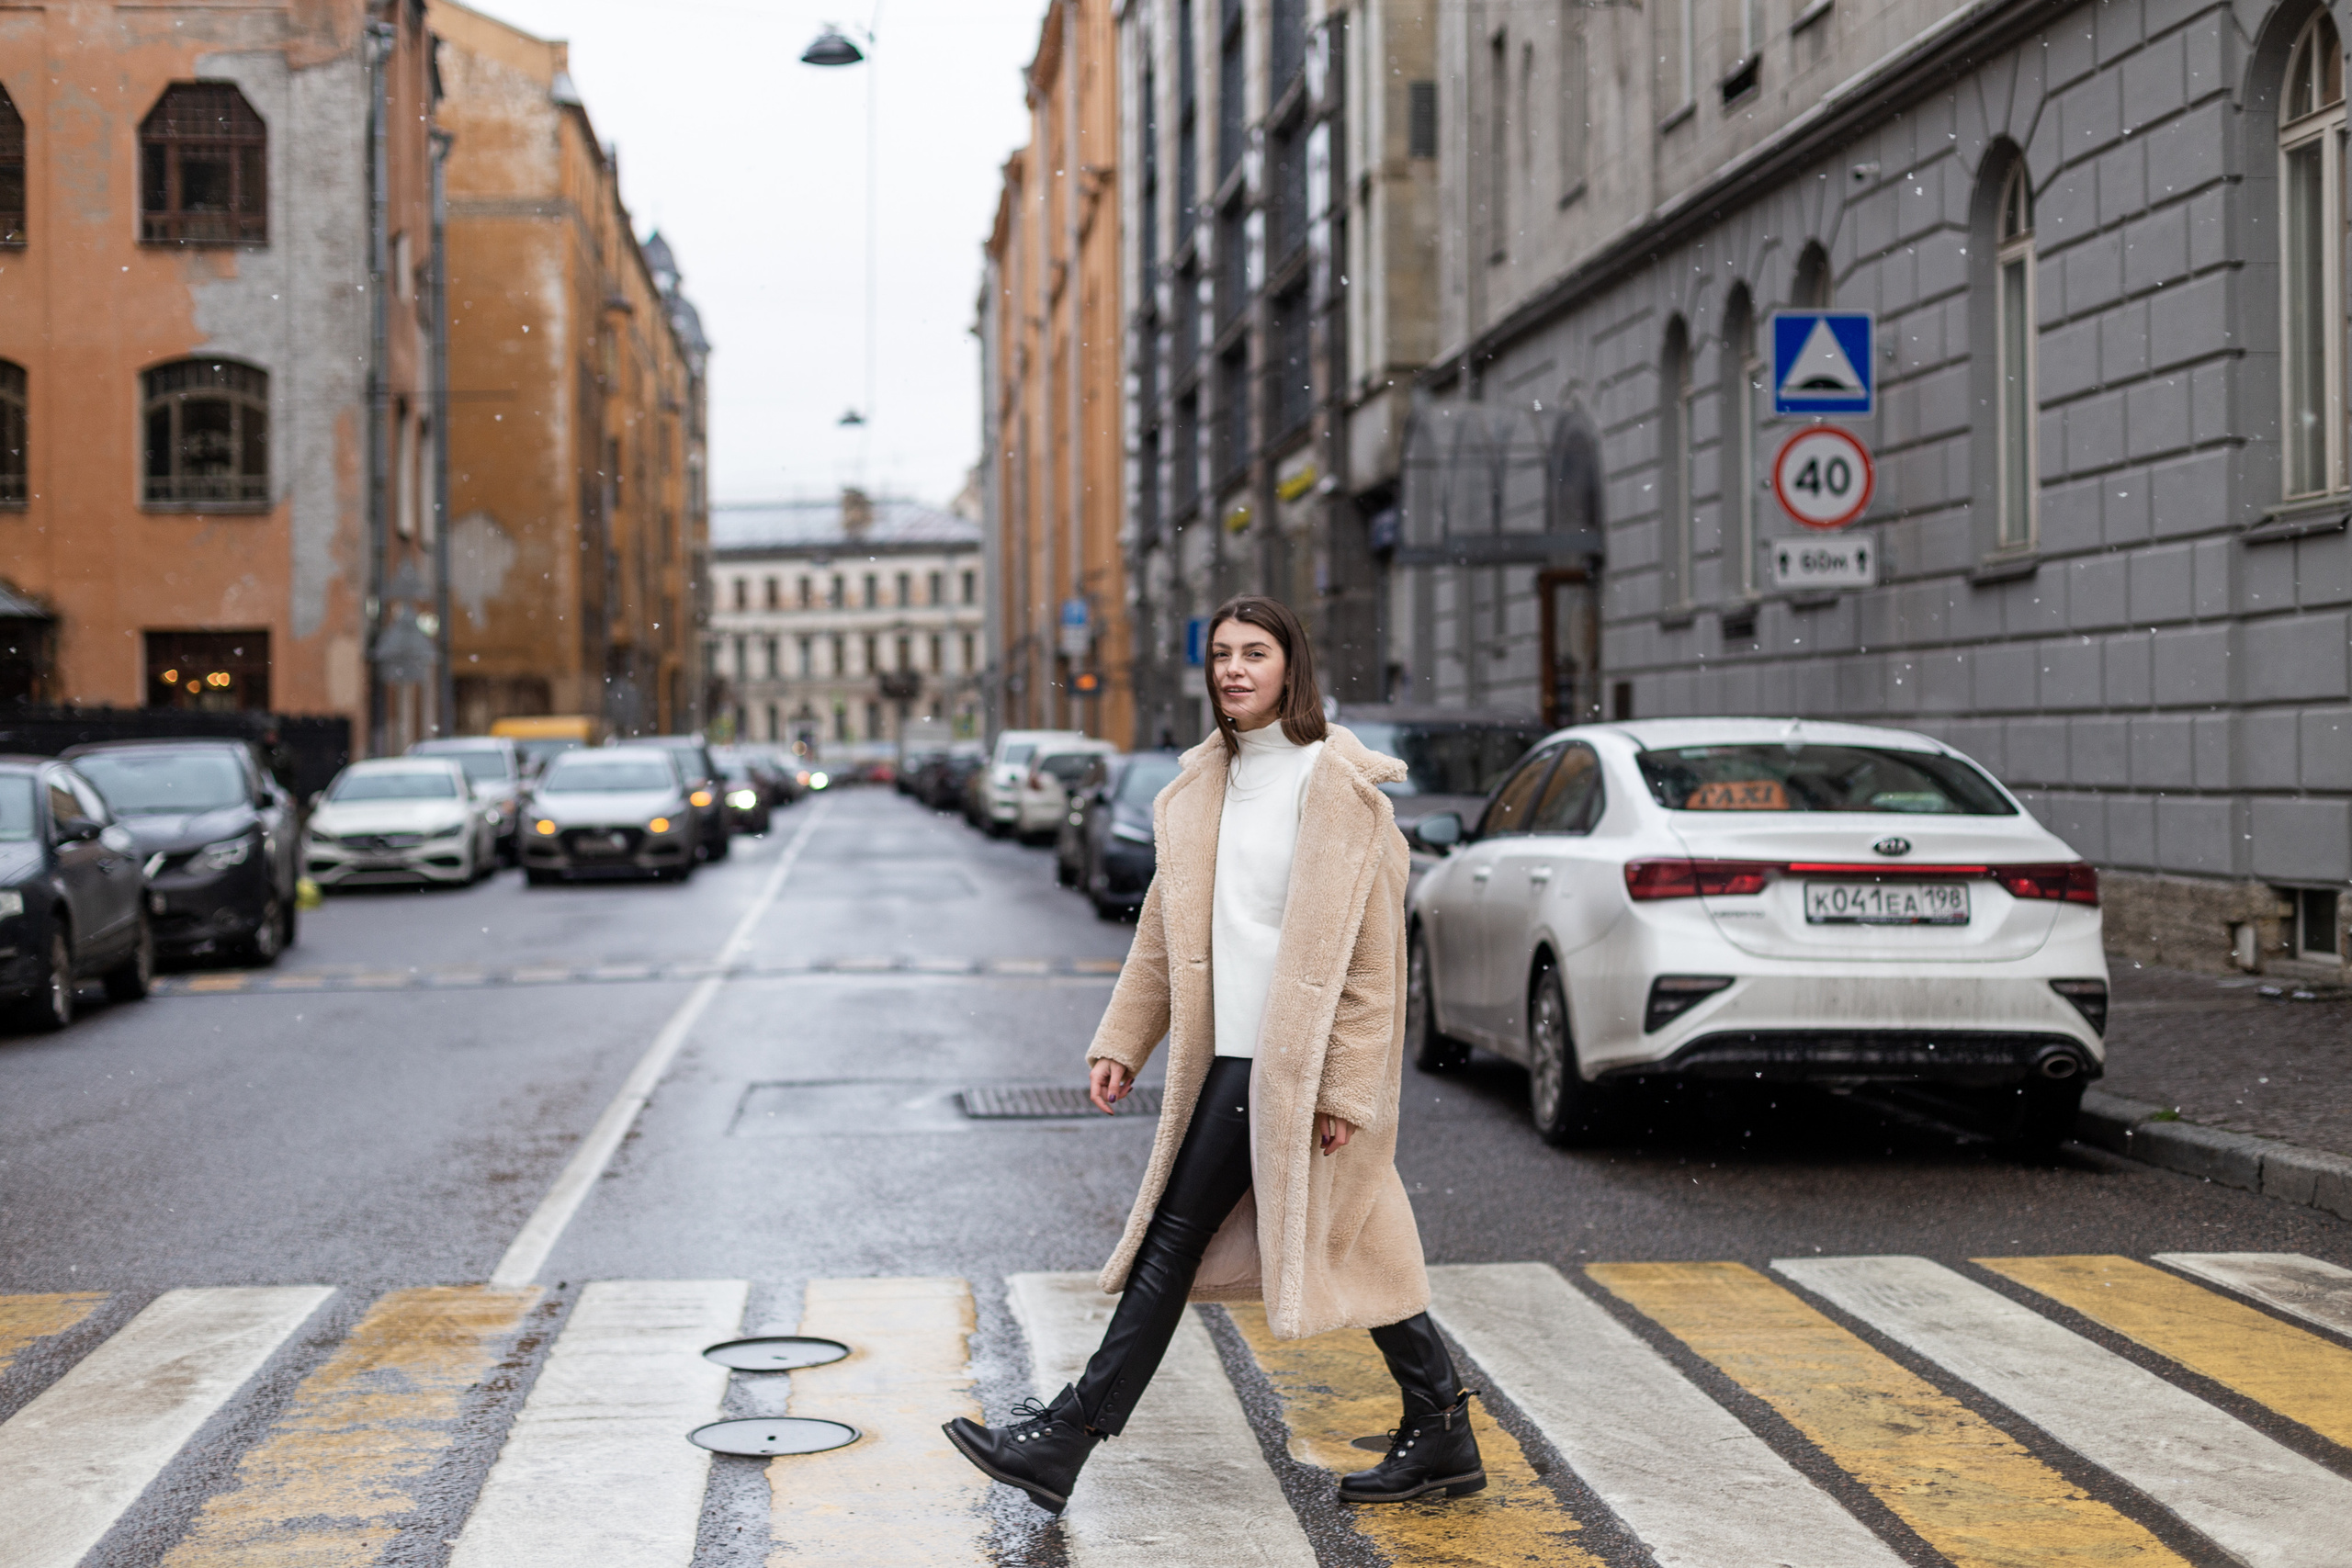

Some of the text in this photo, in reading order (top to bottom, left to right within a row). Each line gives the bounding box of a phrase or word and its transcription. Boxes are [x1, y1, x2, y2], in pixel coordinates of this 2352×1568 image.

[1795, 457, 1850, 496] 40
[1699, 784, 1773, 806] TAXI
[1924, 886, 1962, 908] 198
